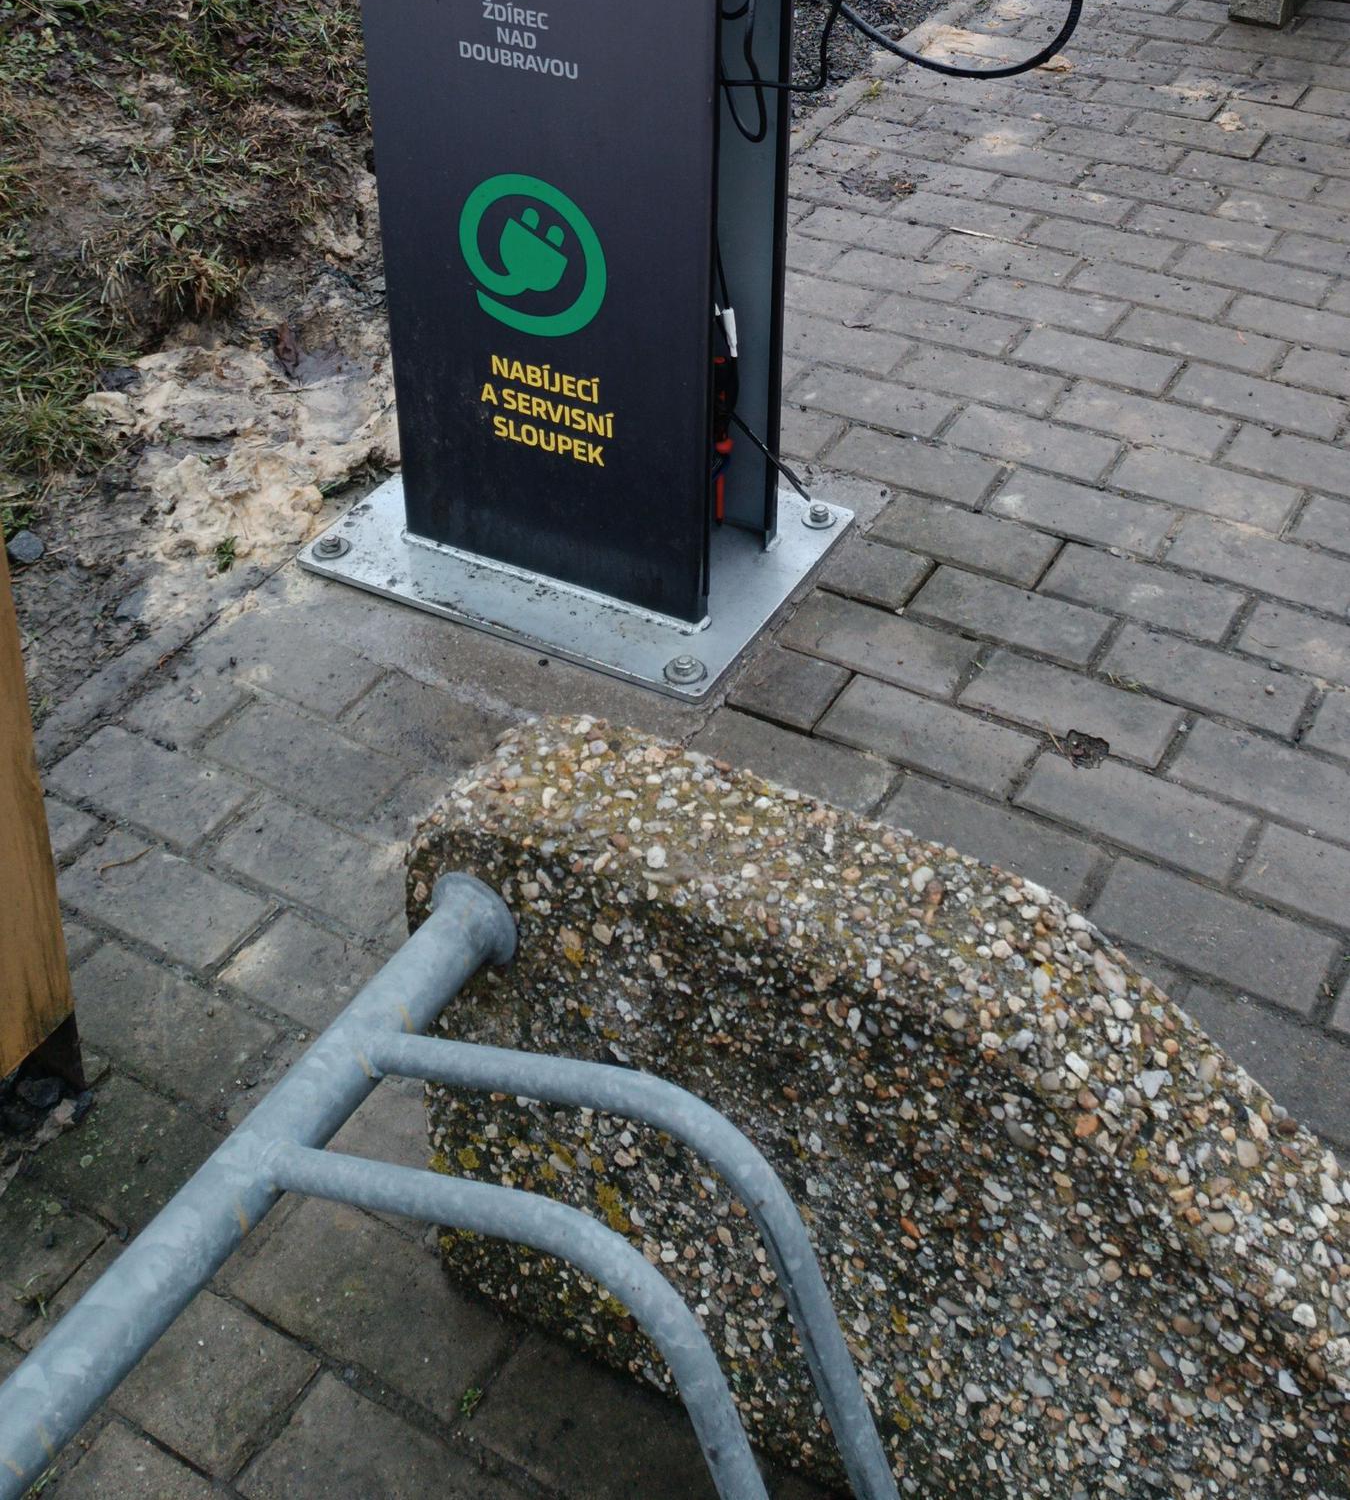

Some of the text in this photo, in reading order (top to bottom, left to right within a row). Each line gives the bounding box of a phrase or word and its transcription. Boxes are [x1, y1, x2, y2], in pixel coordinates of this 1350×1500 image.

[458, 40, 578, 80] DOUBRAVOU
[496, 26, 537, 50] NAD
[490, 355, 599, 405] NABÍJECÍ
[480, 383, 615, 440] A SERVISNÍ
[492, 415, 605, 467] SLOUPEK
